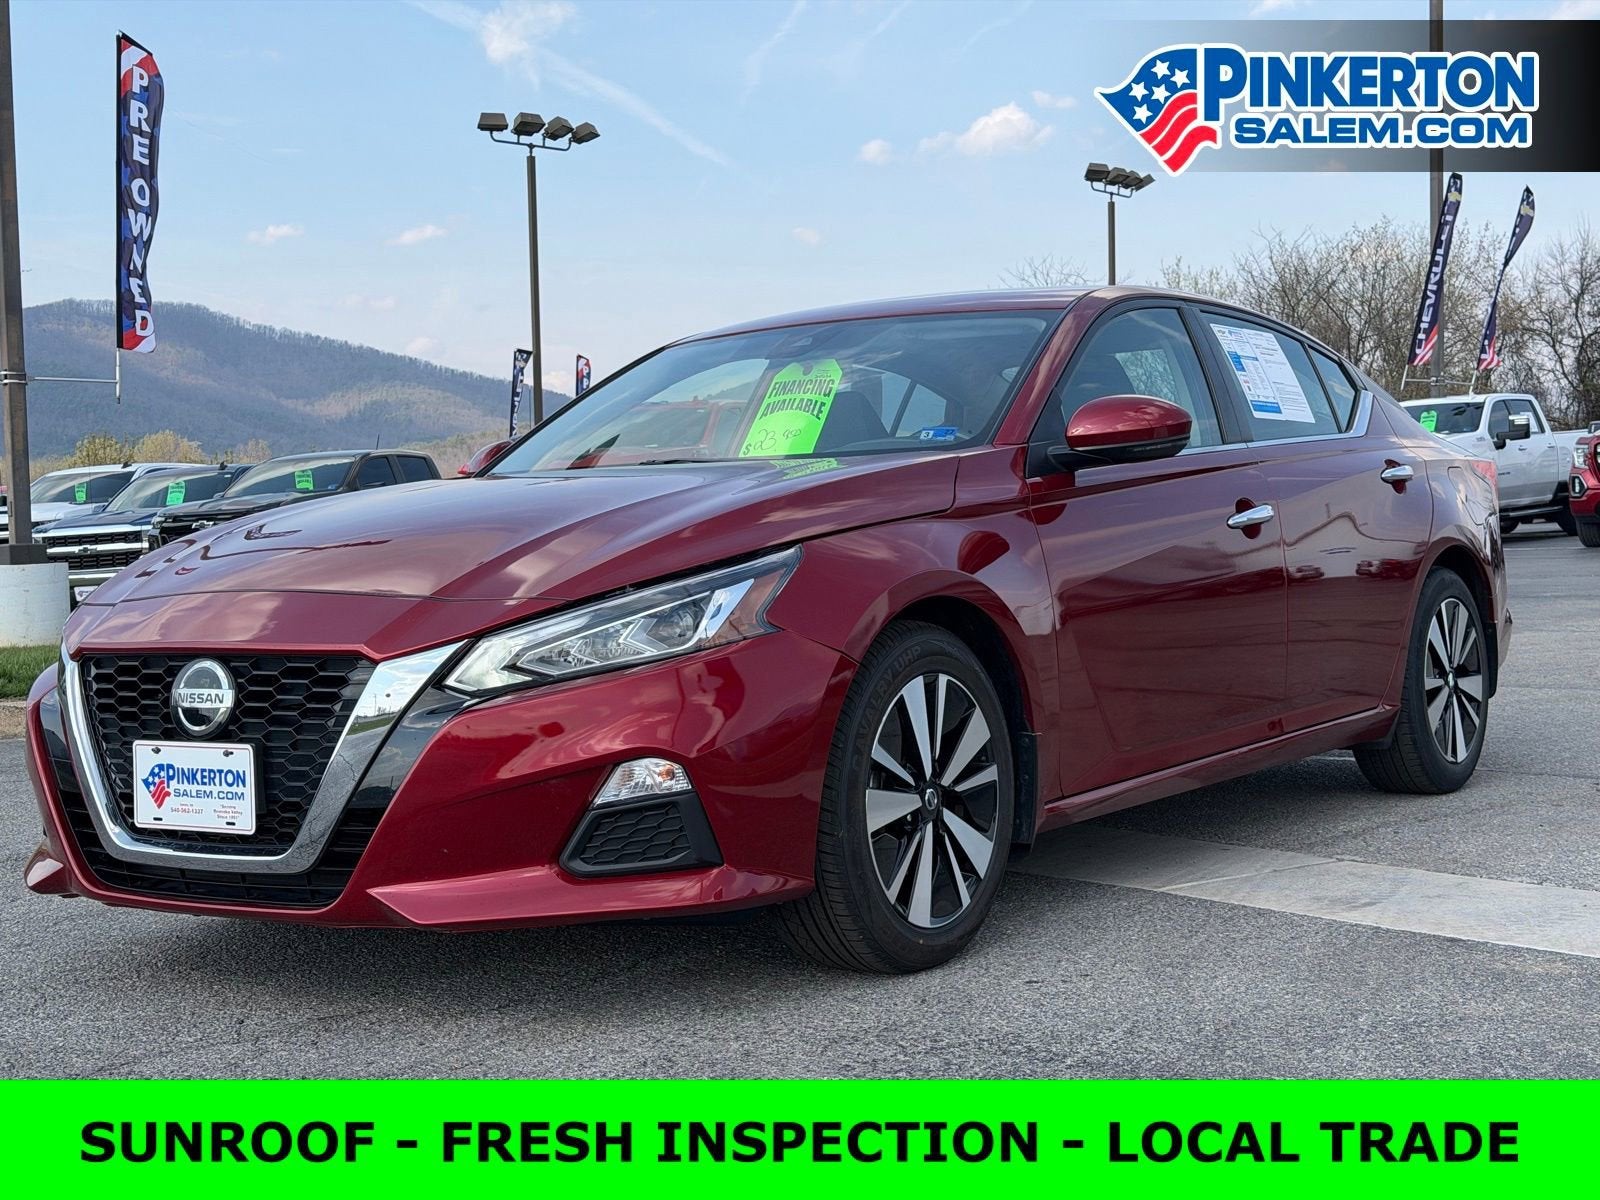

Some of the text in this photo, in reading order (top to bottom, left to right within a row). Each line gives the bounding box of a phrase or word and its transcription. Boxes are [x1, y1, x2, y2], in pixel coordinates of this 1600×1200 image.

[128, 65, 155, 337] PRE OWNED
[768, 378, 835, 399] FINANCING
[759, 397, 826, 421] AVAILABLE
[178, 692, 224, 704] NISSAN
[165, 764, 246, 788] PINKERTON
[174, 788, 245, 801] SALEM.COM
